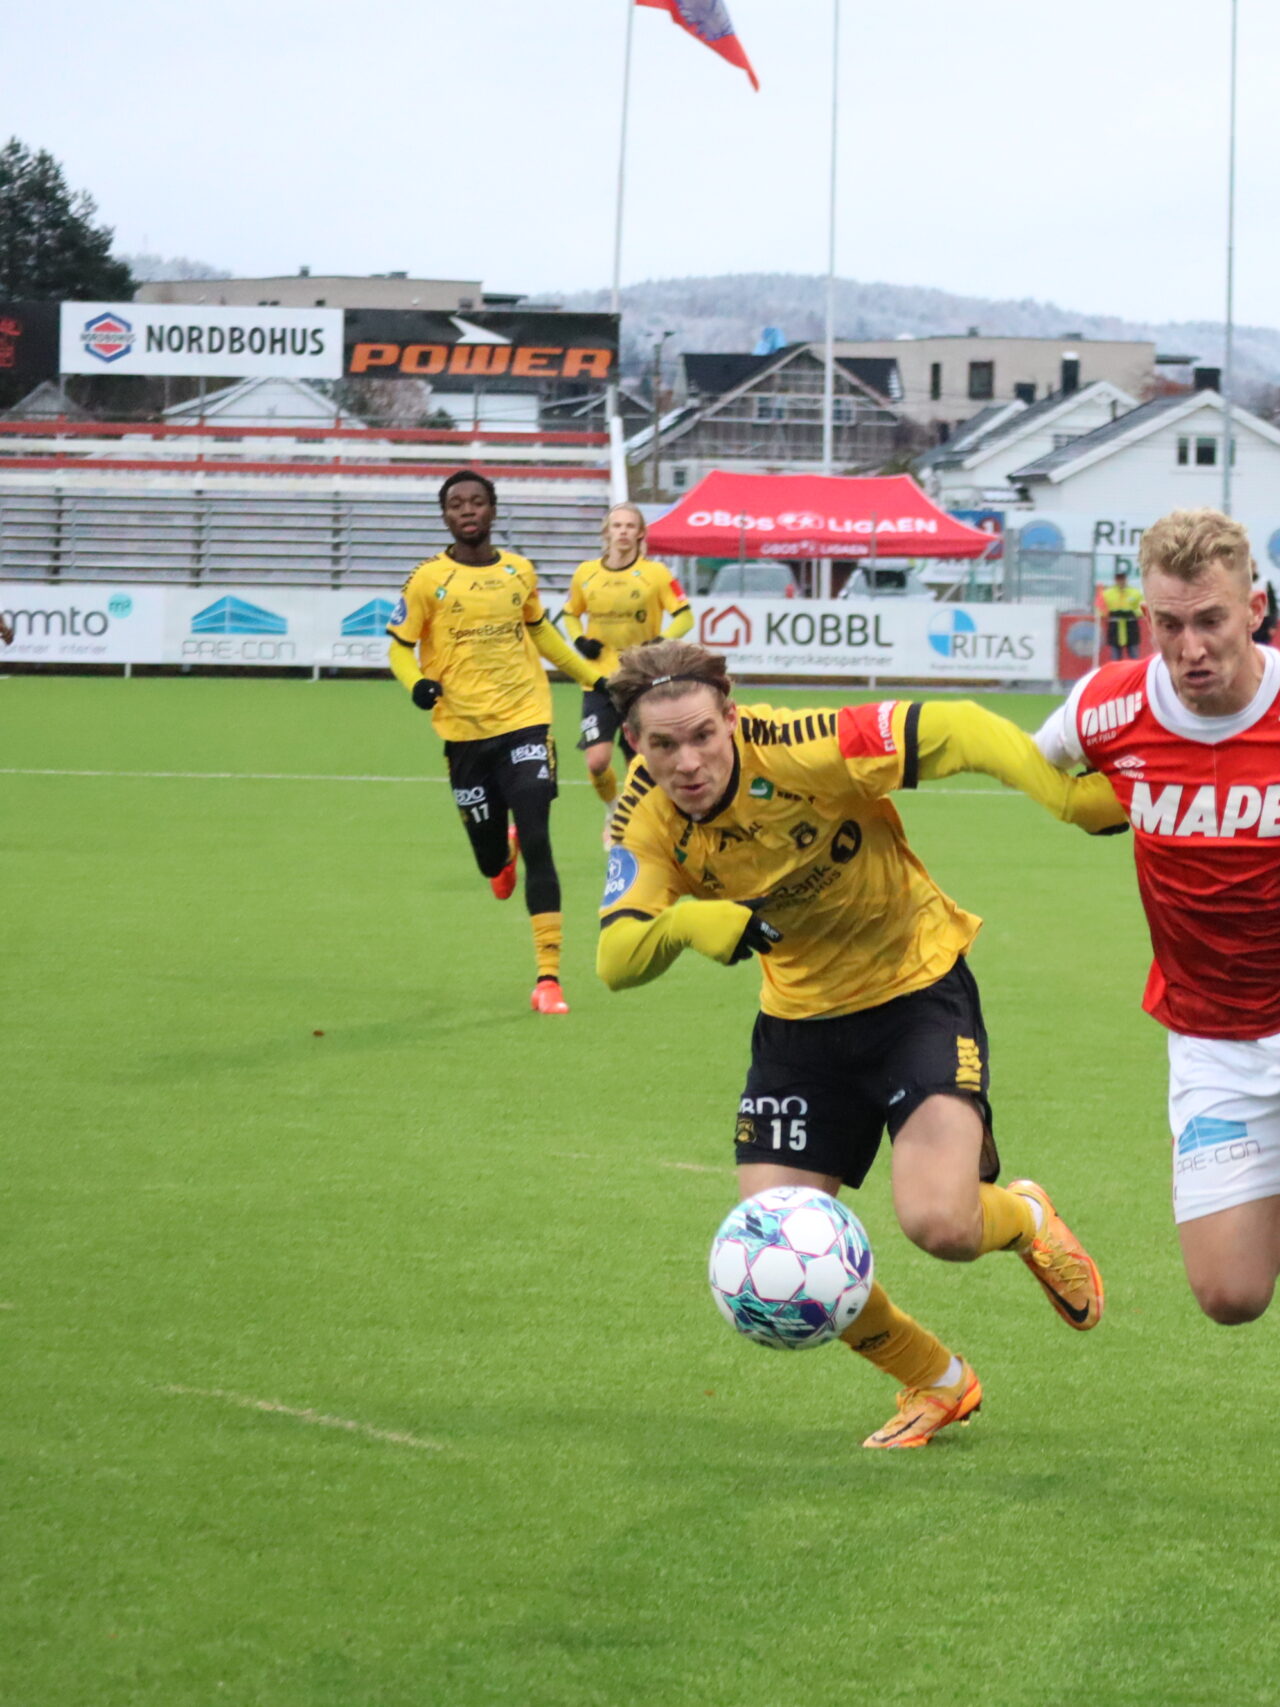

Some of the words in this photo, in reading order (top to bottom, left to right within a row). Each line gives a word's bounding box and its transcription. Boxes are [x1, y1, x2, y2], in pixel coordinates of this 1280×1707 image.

[146, 325, 326, 356] NORDBOHUS
[350, 343, 613, 378] POWER
[687, 511, 775, 531] OBOS
[828, 517, 938, 533] LIGAEN
[766, 613, 894, 647] KOBBL
[332, 642, 387, 662] PRE
[953, 634, 1034, 660] RITAS
[471, 802, 490, 824] 17
[771, 1118, 808, 1151] 15
